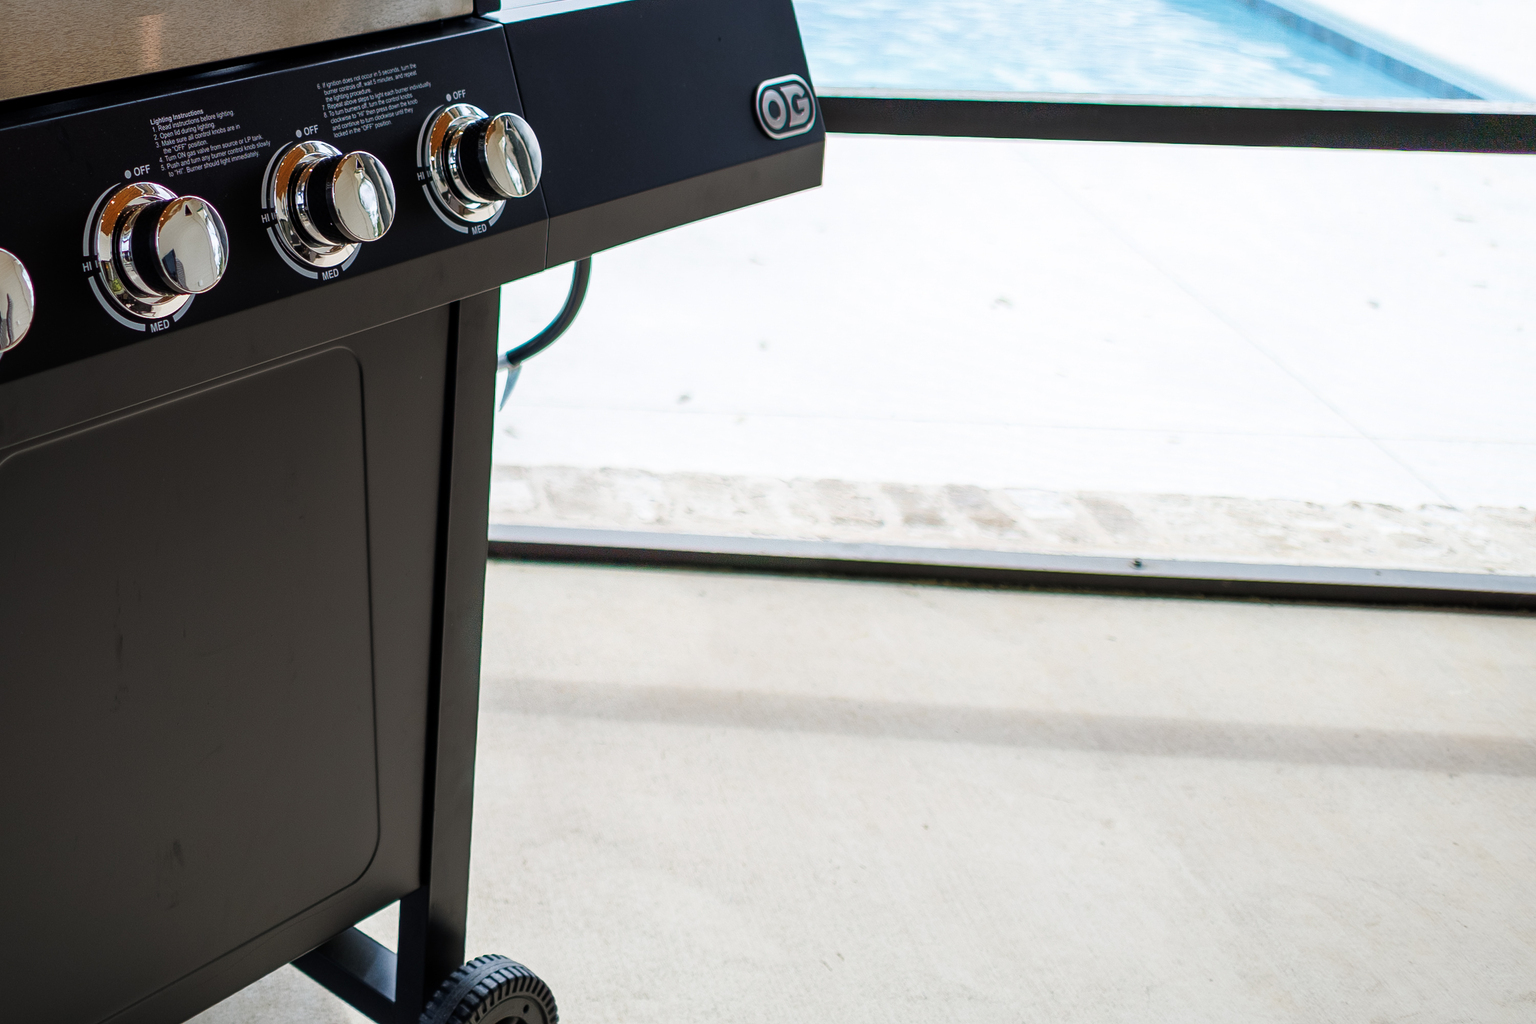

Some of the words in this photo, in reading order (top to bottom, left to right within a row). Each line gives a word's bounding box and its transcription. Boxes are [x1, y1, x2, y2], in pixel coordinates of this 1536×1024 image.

[326, 80, 342, 89] ignition
[339, 84, 356, 92] controls
[404, 70, 417, 78] repeat
[327, 101, 343, 110] Repeat
[344, 98, 357, 106] above
[375, 92, 384, 100] light
[333, 93, 349, 102] lighting
[385, 96, 400, 104] control
[452, 89, 466, 100] OFF
[330, 114, 351, 124] clockwise
[376, 106, 388, 114] press
[407, 98, 418, 106] knob
[762, 84, 810, 130] OG
[150, 116, 172, 125] Lighting
[172, 109, 203, 120] Instructions
[172, 118, 200, 128] instructions
[200, 114, 216, 122] before
[342, 120, 360, 129] continue
[374, 112, 394, 121] clockwise
[181, 126, 197, 134] during
[195, 130, 211, 139] control
[211, 127, 226, 135] knobs
[303, 124, 319, 136] OFF
[333, 130, 348, 138] locked
[172, 143, 187, 151] "OFF"
[187, 150, 196, 158] gas
[222, 140, 238, 148] source
[166, 161, 180, 169] Push
[211, 150, 226, 159] burner
[227, 146, 243, 155] control
[244, 143, 256, 151] knob
[256, 140, 271, 148] slowly
[133, 164, 151, 176] OFF
[186, 165, 203, 173] Burner
[204, 160, 220, 169] should
[220, 157, 231, 166] light
[472, 224, 487, 235] MED
[321, 268, 340, 281] MED
[150, 319, 170, 333] MED
